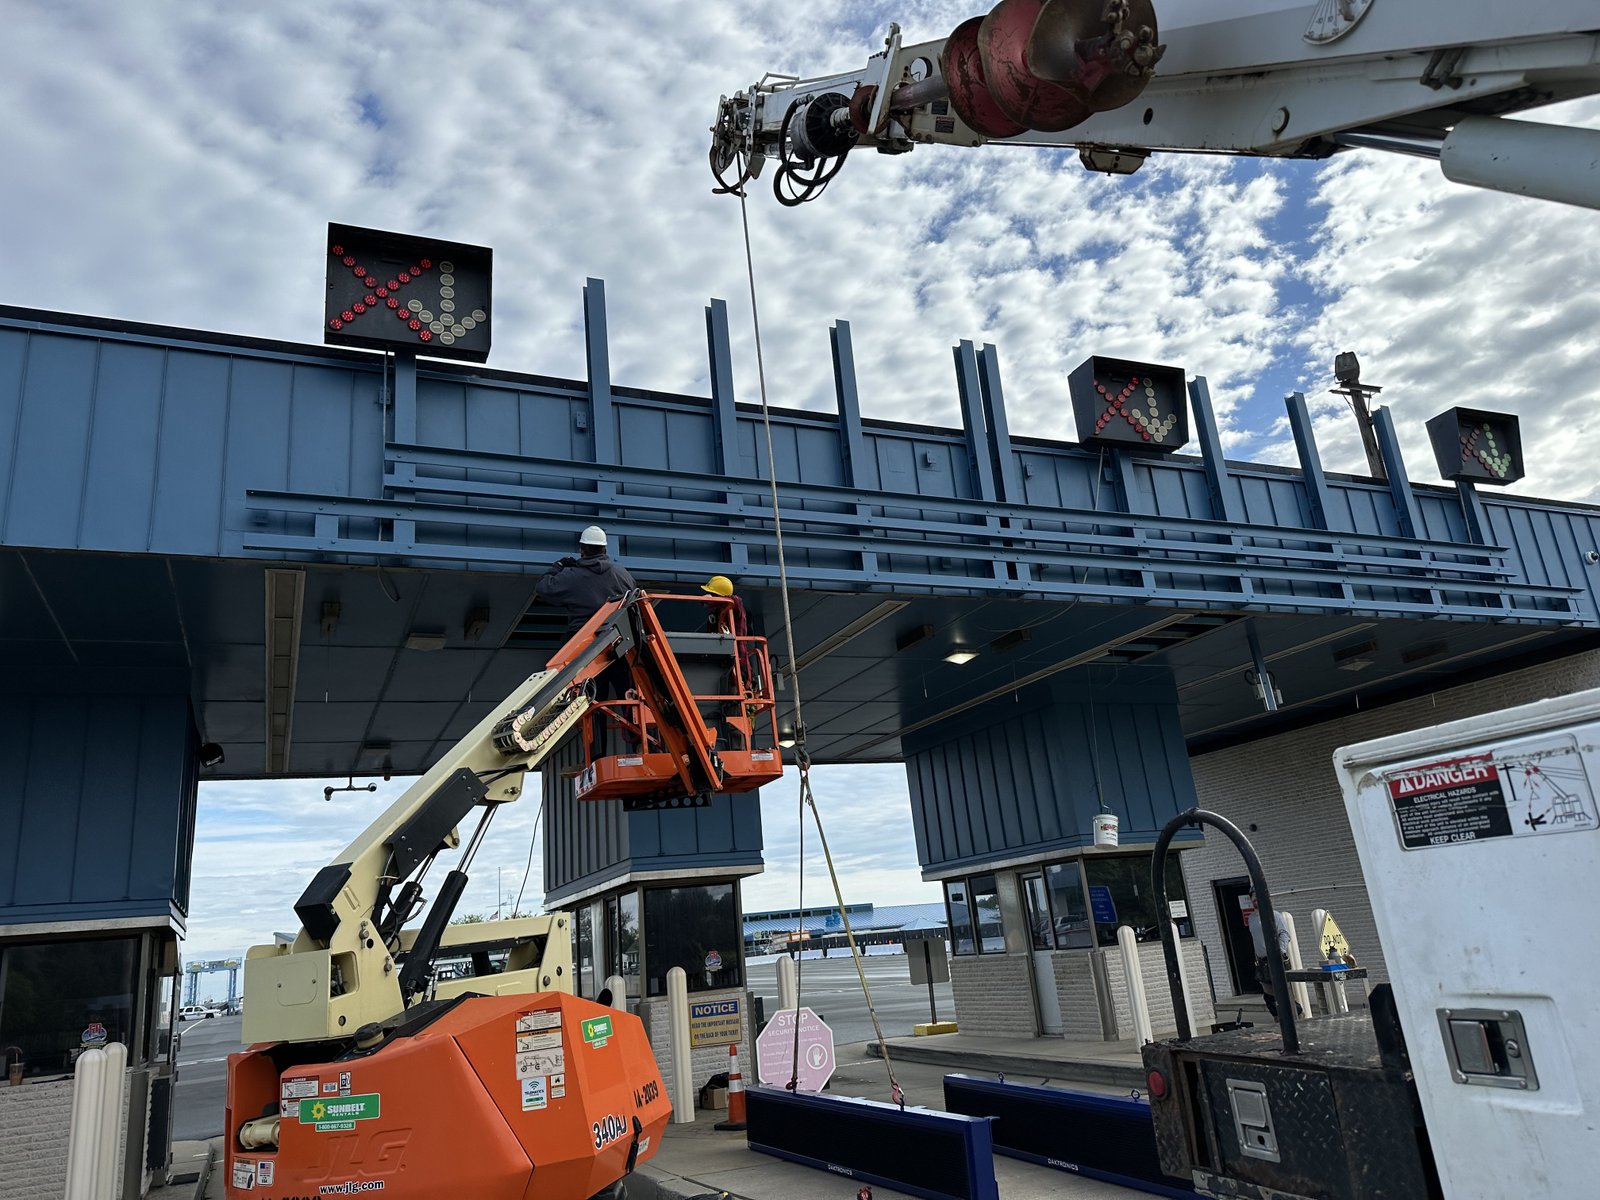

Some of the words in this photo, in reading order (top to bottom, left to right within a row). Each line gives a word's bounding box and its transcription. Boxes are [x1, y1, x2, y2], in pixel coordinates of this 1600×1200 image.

[1413, 761, 1489, 790] DANGER
[1413, 792, 1447, 803] ELECTRICAL
[1448, 787, 1476, 796] HAZARDS
[1429, 835, 1448, 845] KEEP
[1451, 831, 1476, 841] CLEAR
[695, 1003, 735, 1016] NOTICE
[768, 1028, 794, 1037] SECURITY
[327, 1103, 365, 1114] SUNBELT
[593, 1114, 628, 1150] 340AJ
[303, 1128, 411, 1182] JLG
[828, 1164, 852, 1176] DAKTRONICS
[1048, 1158, 1078, 1171] DAKTRONICS
[320, 1180, 384, 1195] www.jlg.com
